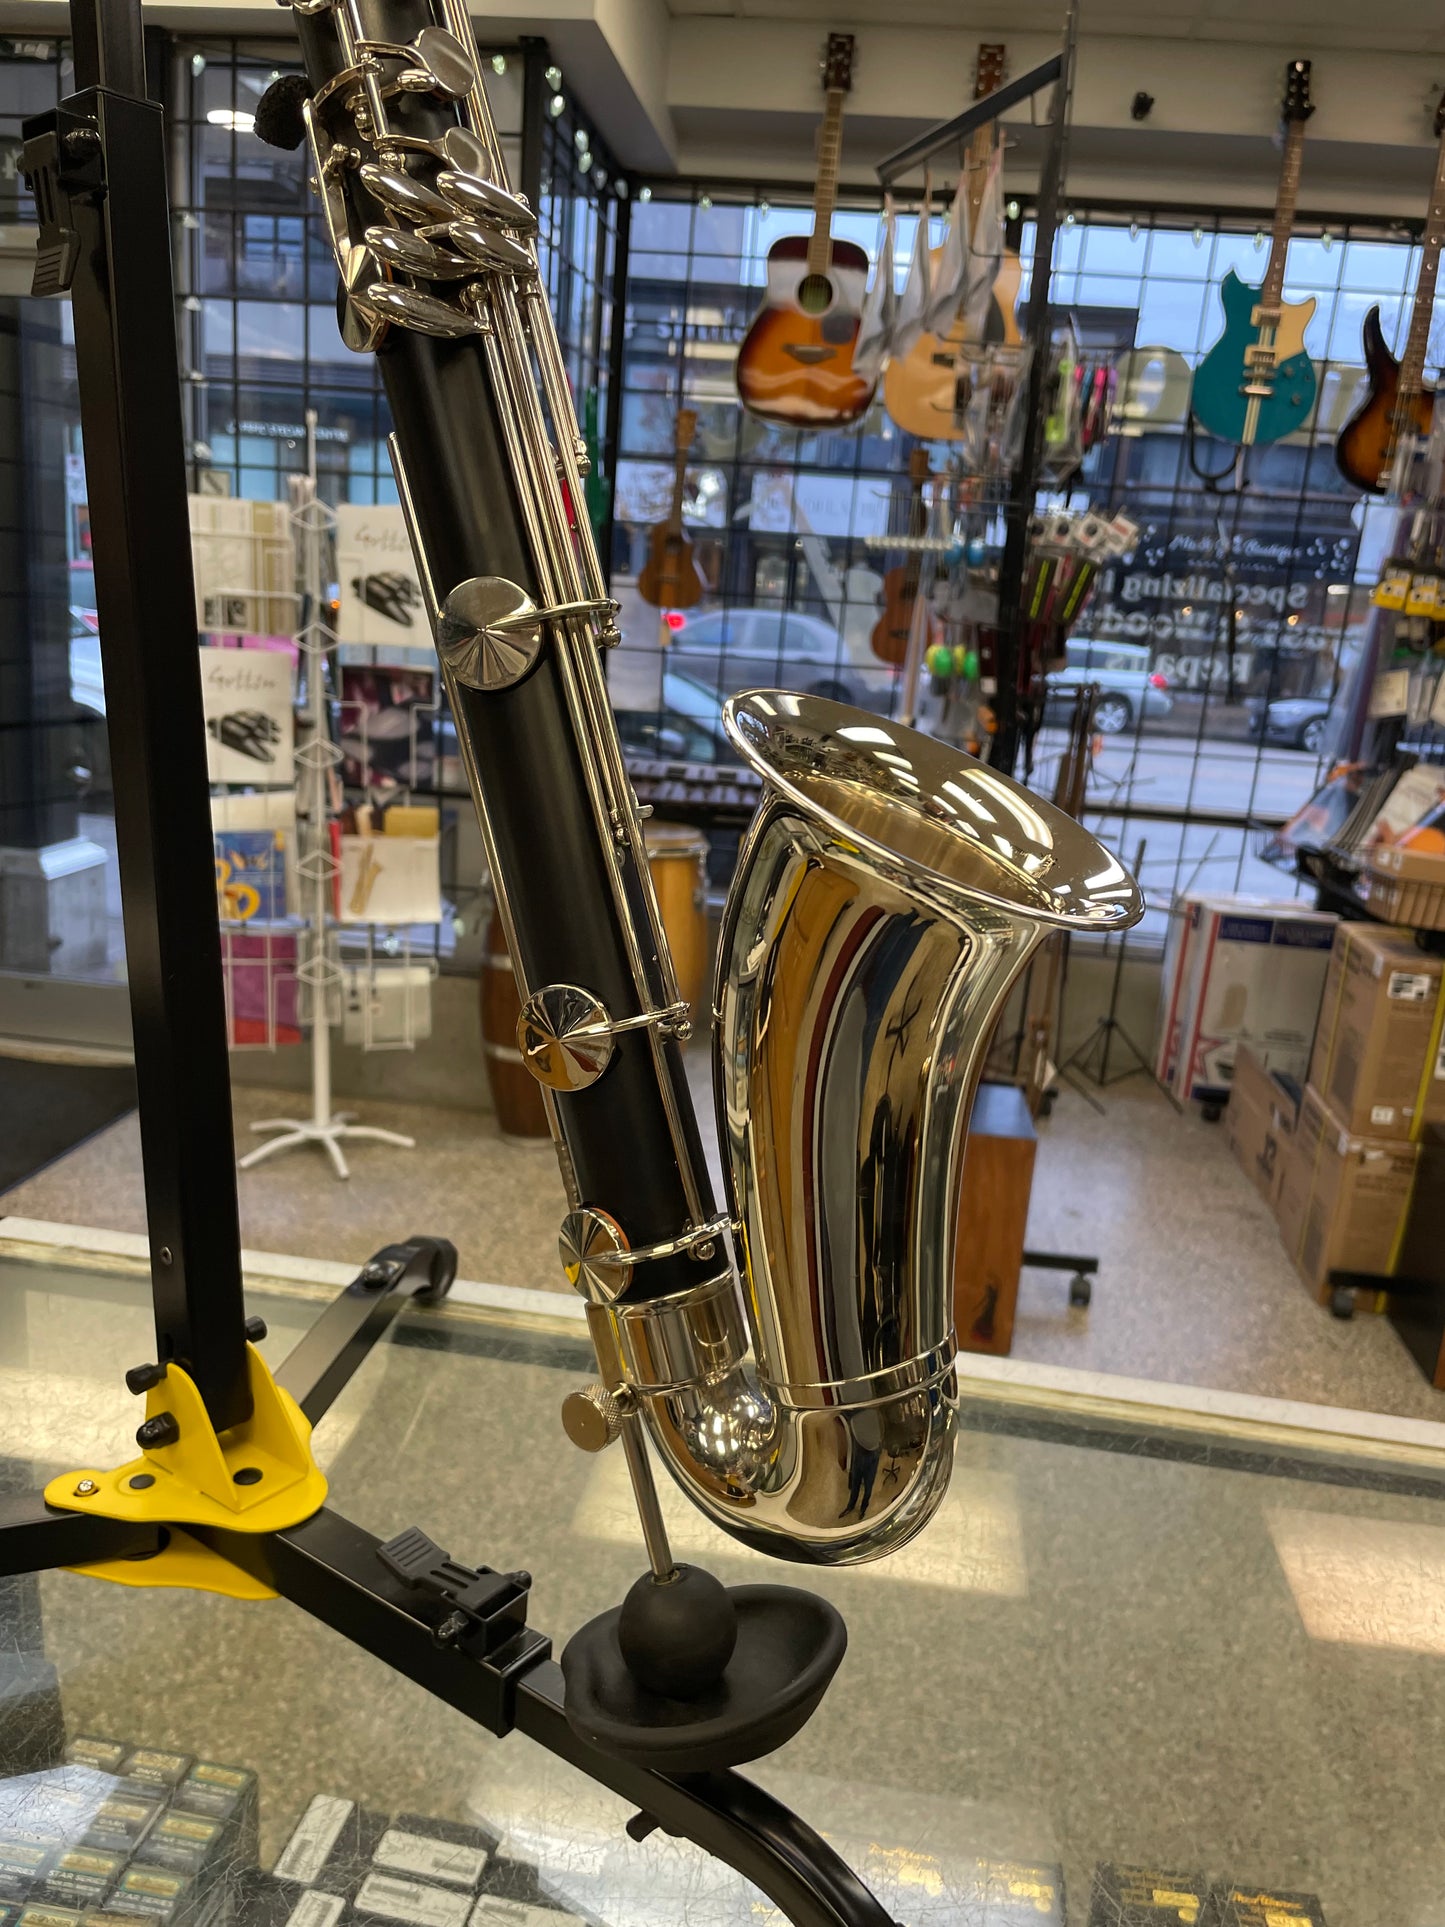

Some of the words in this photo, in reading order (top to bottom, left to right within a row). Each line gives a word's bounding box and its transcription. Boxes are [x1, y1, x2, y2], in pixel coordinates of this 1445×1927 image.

[48, 1869, 74, 1881] STAR
[114, 1891, 141, 1902] STAR
[141, 1895, 175, 1908] SERIES
